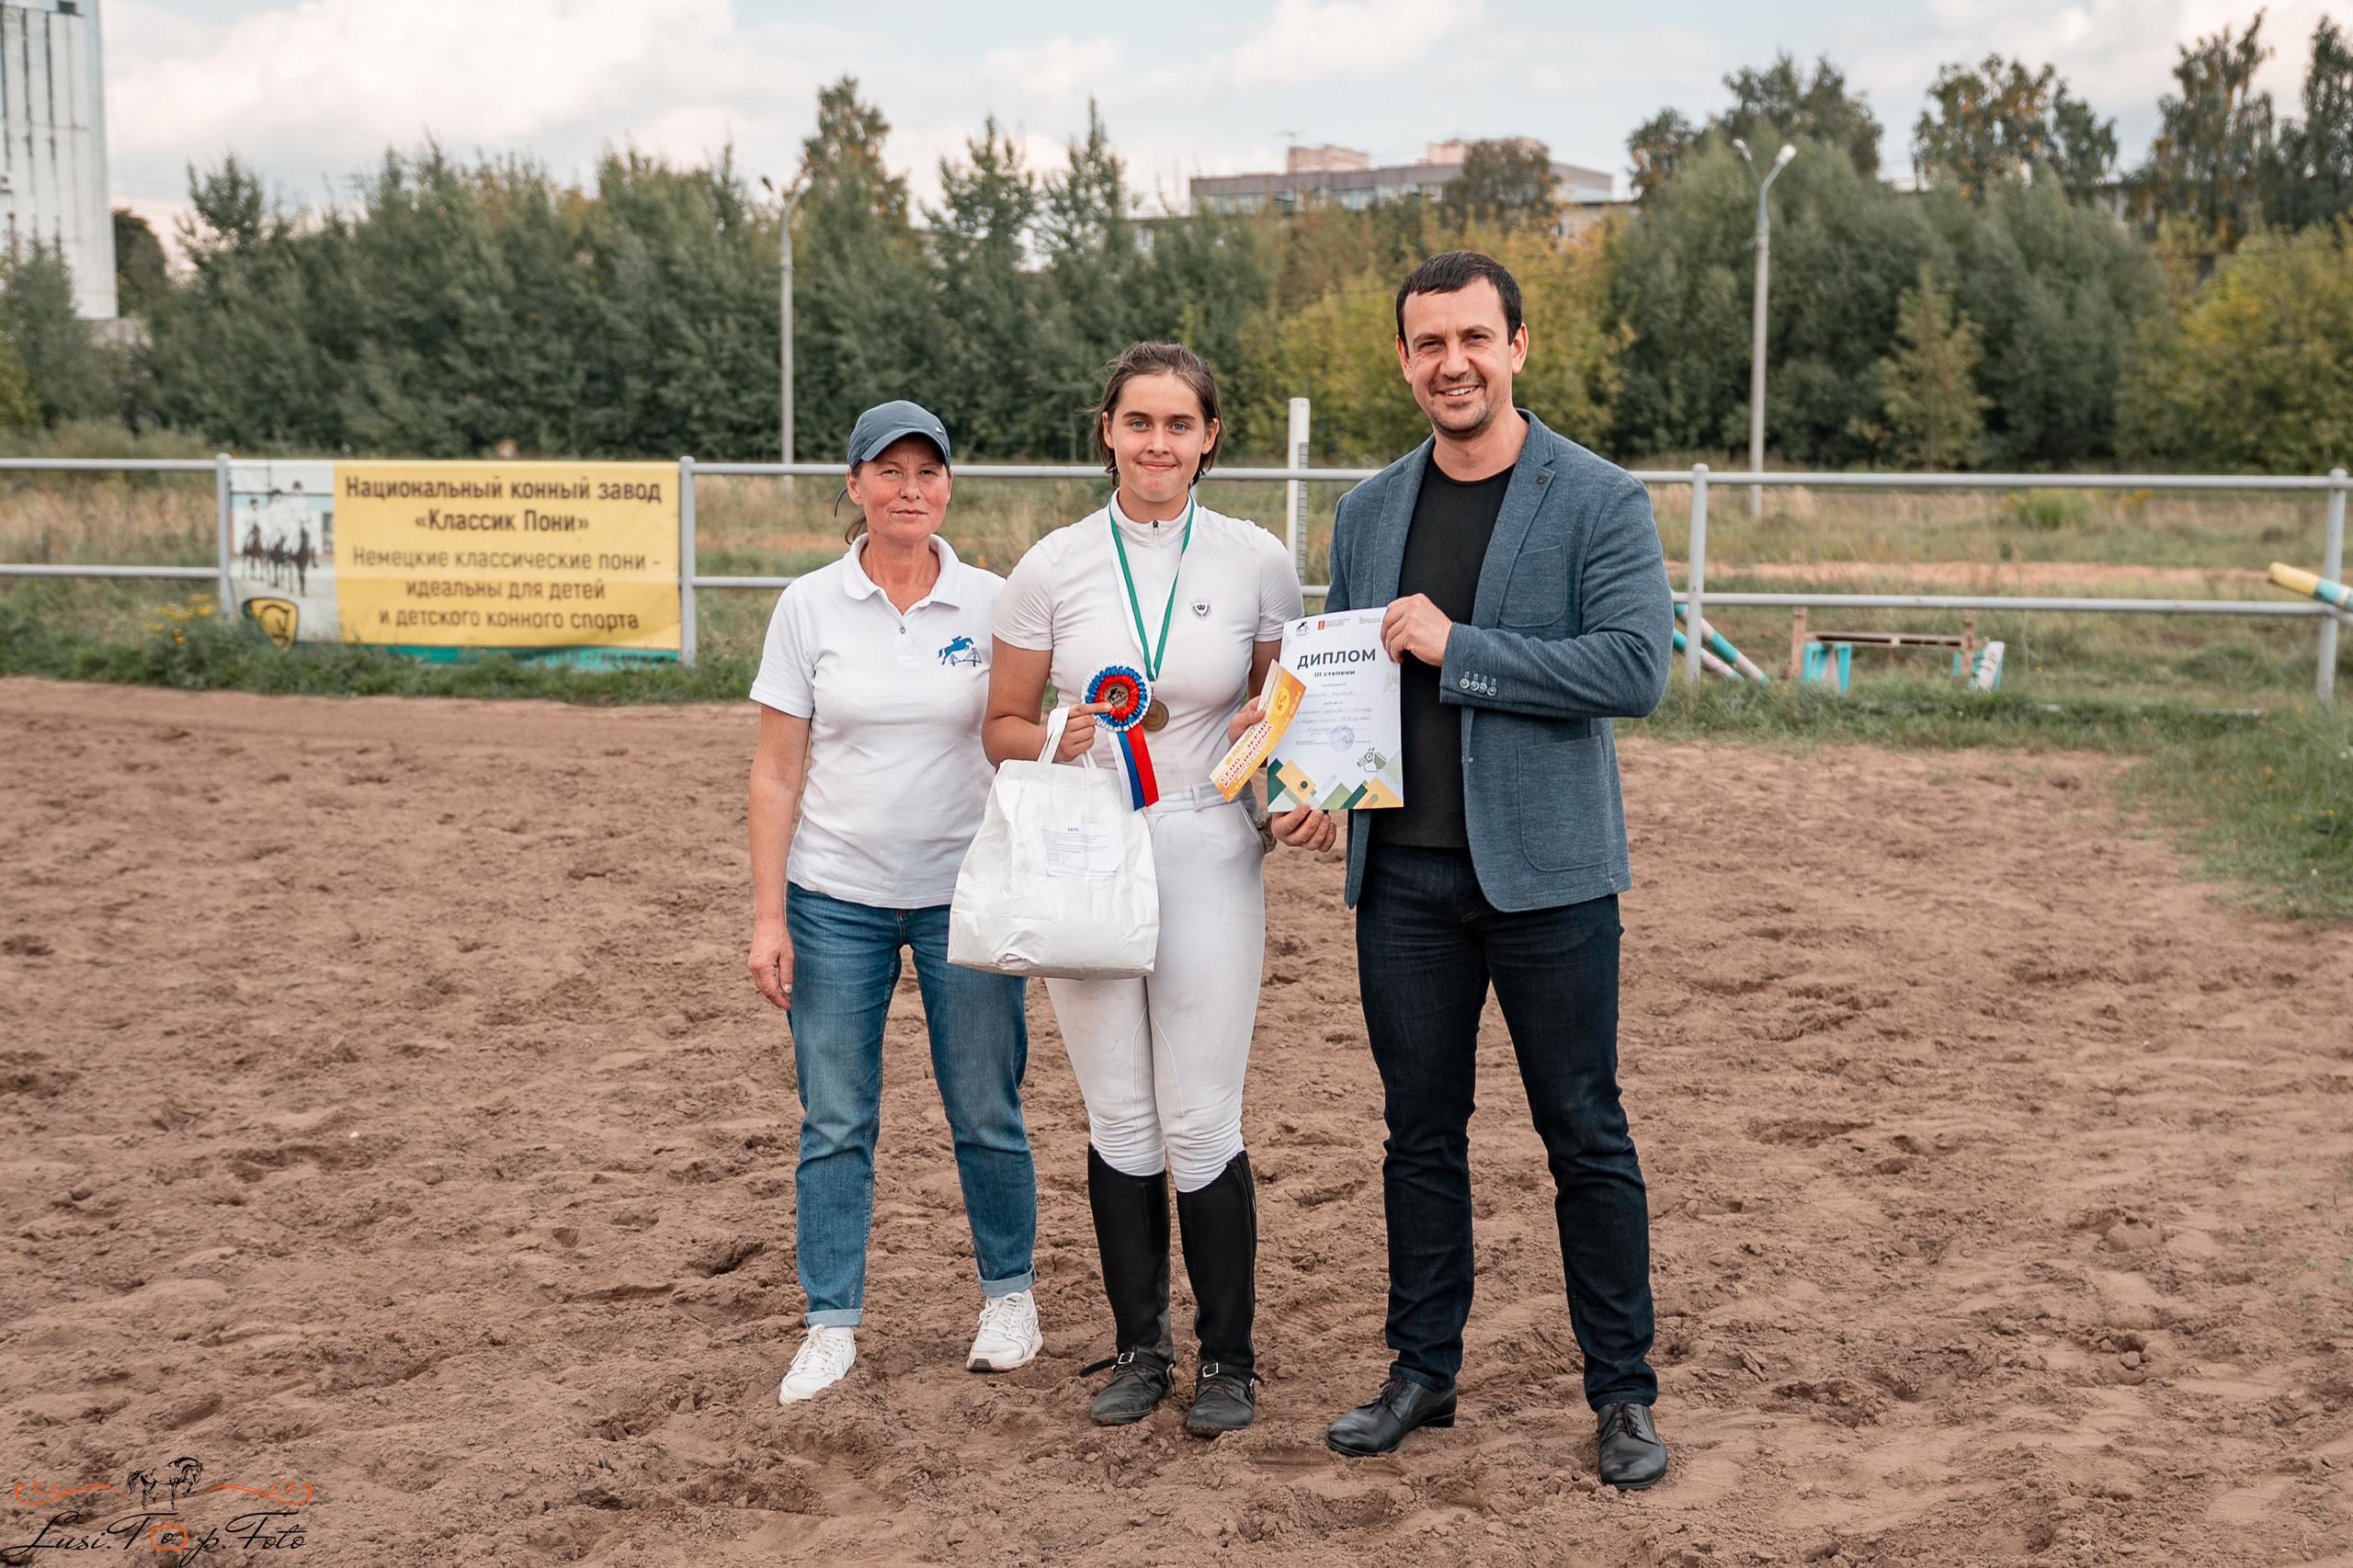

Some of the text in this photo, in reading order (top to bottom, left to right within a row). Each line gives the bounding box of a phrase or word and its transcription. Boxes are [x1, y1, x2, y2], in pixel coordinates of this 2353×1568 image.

[346, 474, 662, 504] Национальный конный завод
[415, 508, 589, 531] «Классик Пони»
[353, 546, 449, 568] Немецкие
[455, 551, 592, 569] классические
[598, 553, 646, 570] пони
[406, 578, 606, 600] идеальны для детей
[379, 609, 639, 632] и детского конного спорта
[1297, 648, 1376, 670] ДИПЛОМ
[1277, 695, 1287, 711] 5%
[1223, 725, 1272, 787] КОМБИКОРМА
[1221, 757, 1240, 782] СЕНО
